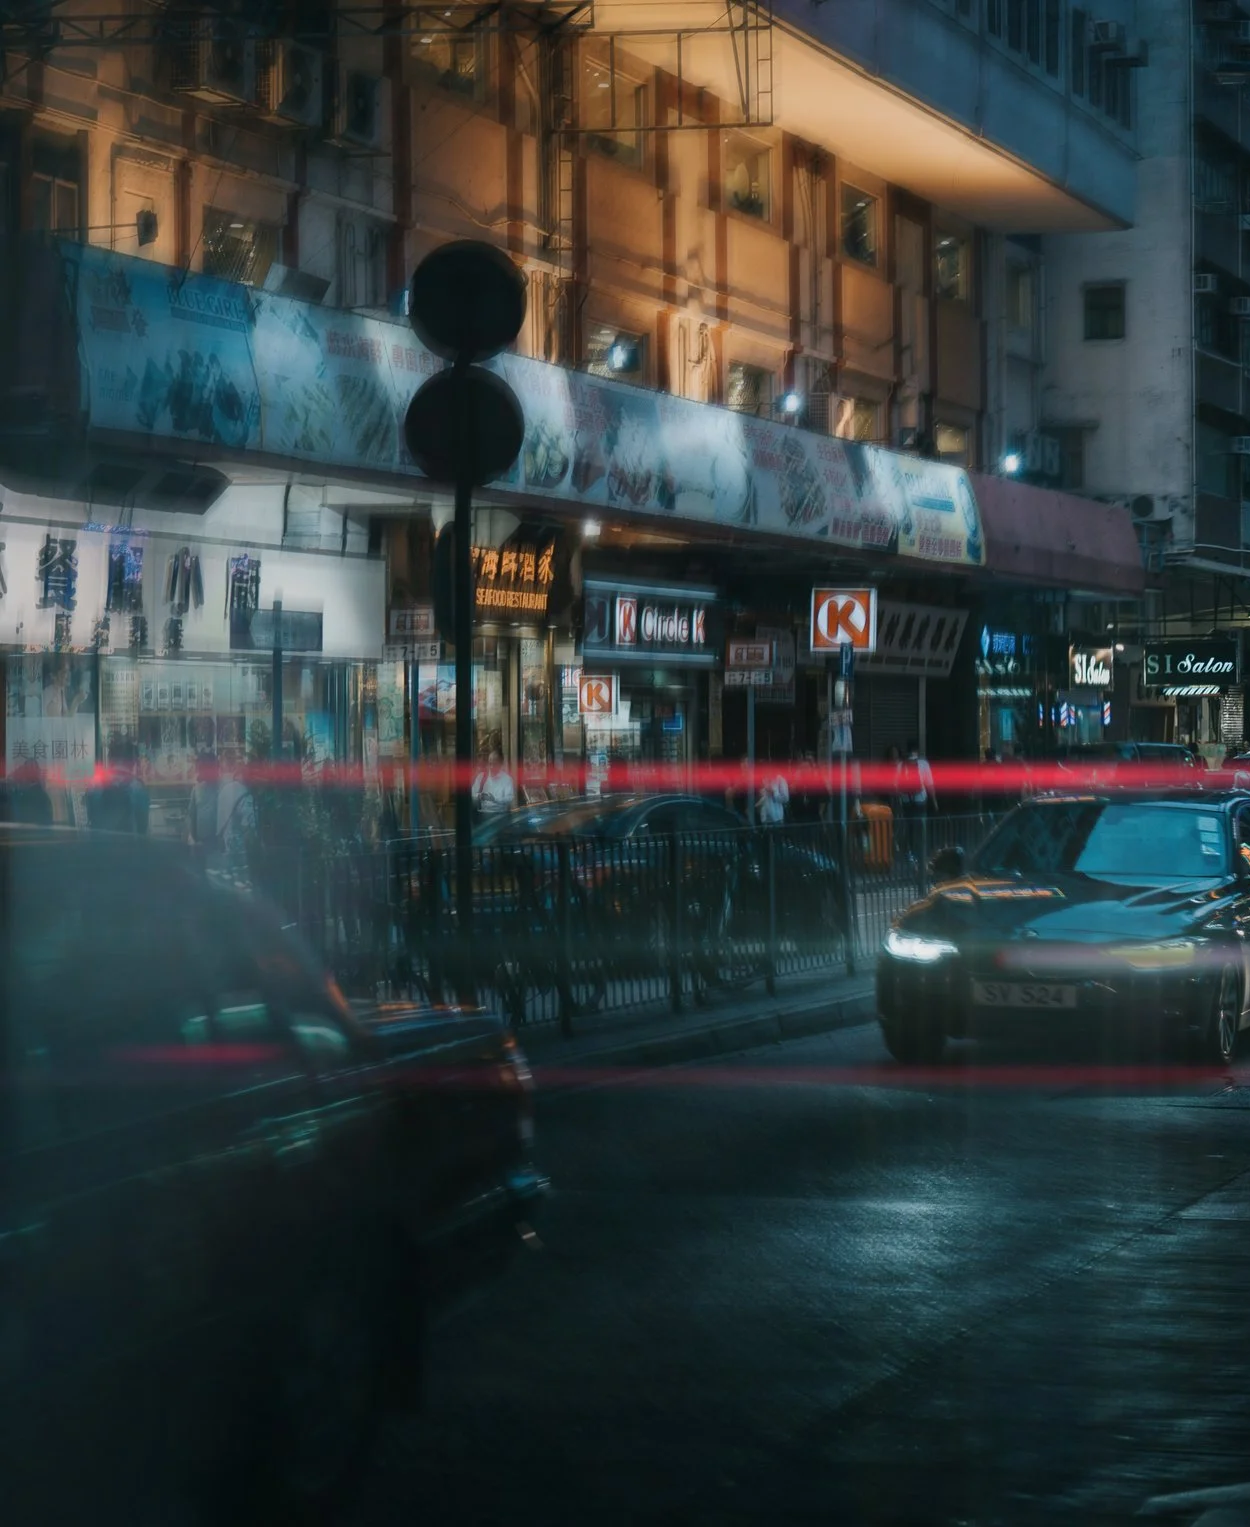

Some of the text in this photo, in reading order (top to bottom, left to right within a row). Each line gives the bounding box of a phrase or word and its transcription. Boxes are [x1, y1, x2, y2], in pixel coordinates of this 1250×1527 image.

[166, 283, 205, 310] BLUE
[206, 294, 245, 321] GIRL
[475, 587, 506, 606] SEAFOOD
[641, 605, 706, 644] Circle K
[1177, 653, 1235, 674] Salon
[11, 738, 89, 760] 美食園林
